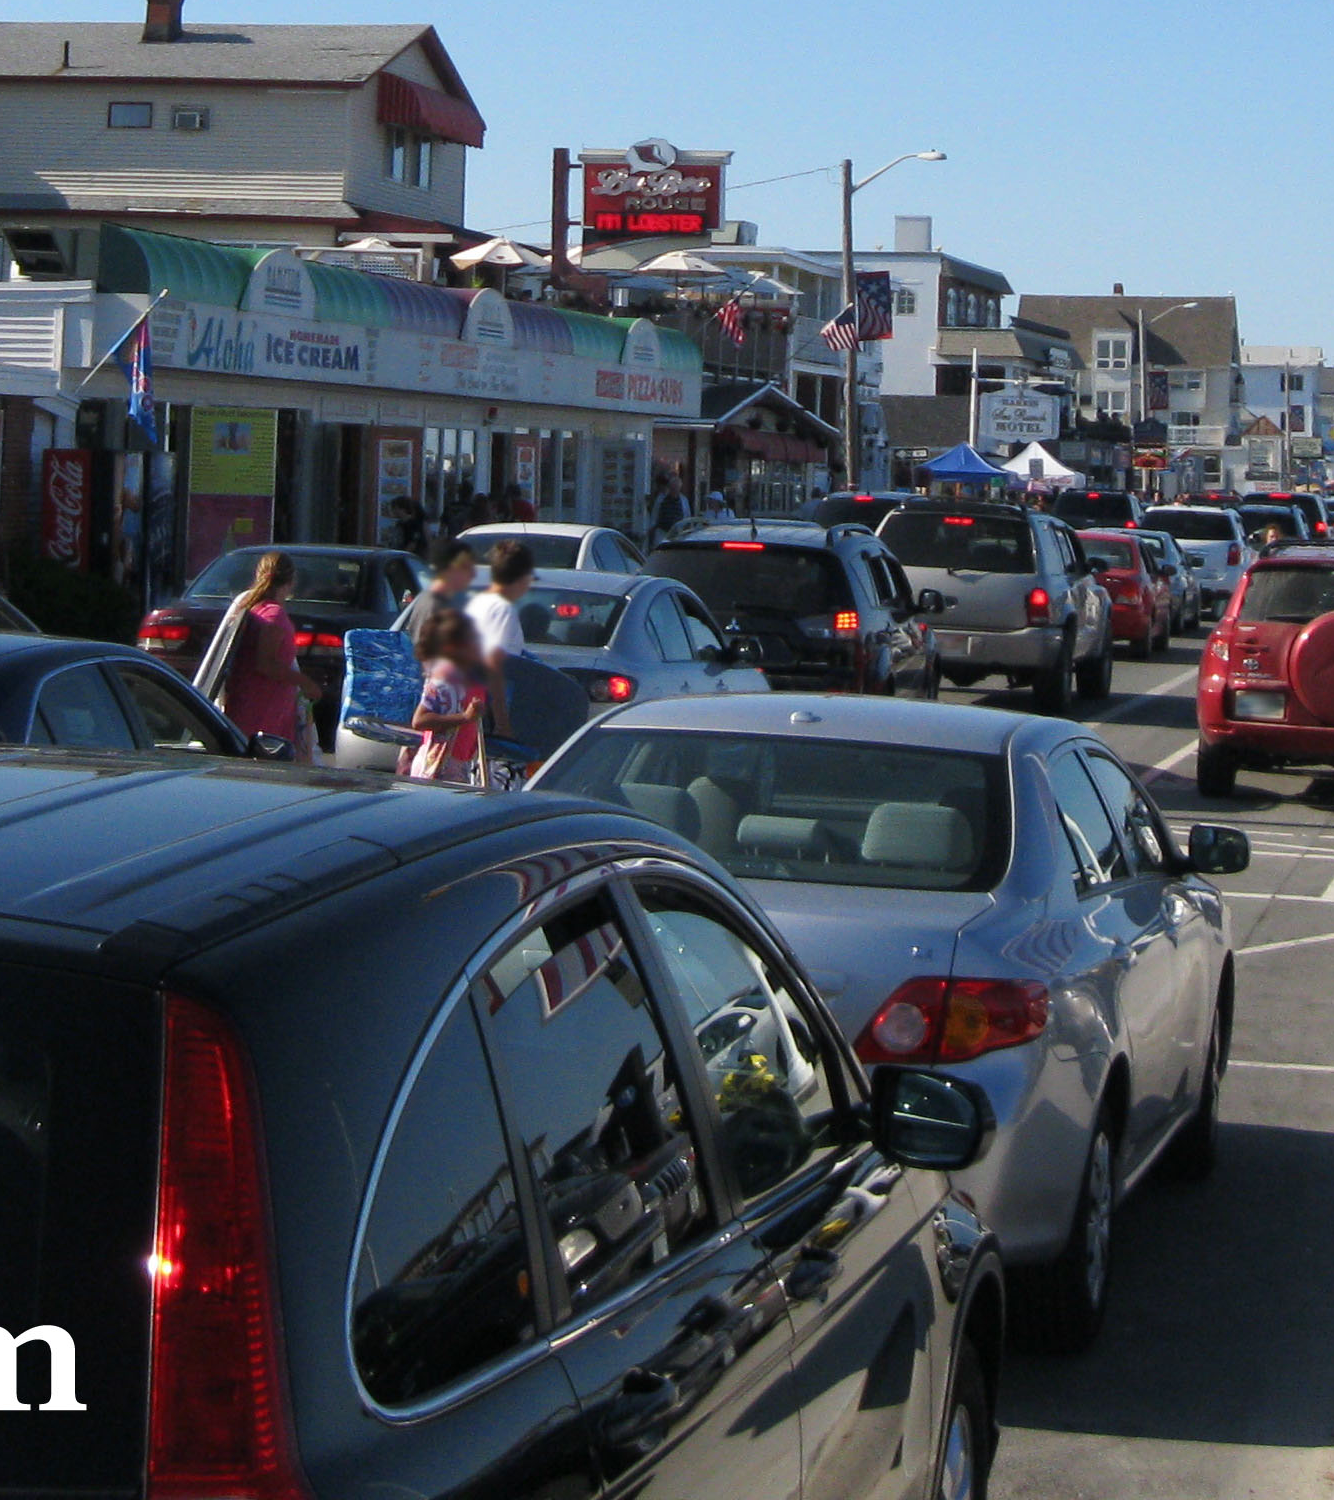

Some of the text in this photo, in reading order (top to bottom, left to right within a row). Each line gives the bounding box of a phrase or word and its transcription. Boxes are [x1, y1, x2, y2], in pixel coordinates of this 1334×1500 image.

[627, 214, 703, 232] LOBSTER
[187, 316, 255, 373] Aloha
[289, 329, 340, 345] HOMEMADE
[266, 333, 295, 366] ICE
[297, 344, 359, 372] CREAM
[995, 421, 1044, 433] MOTEL
